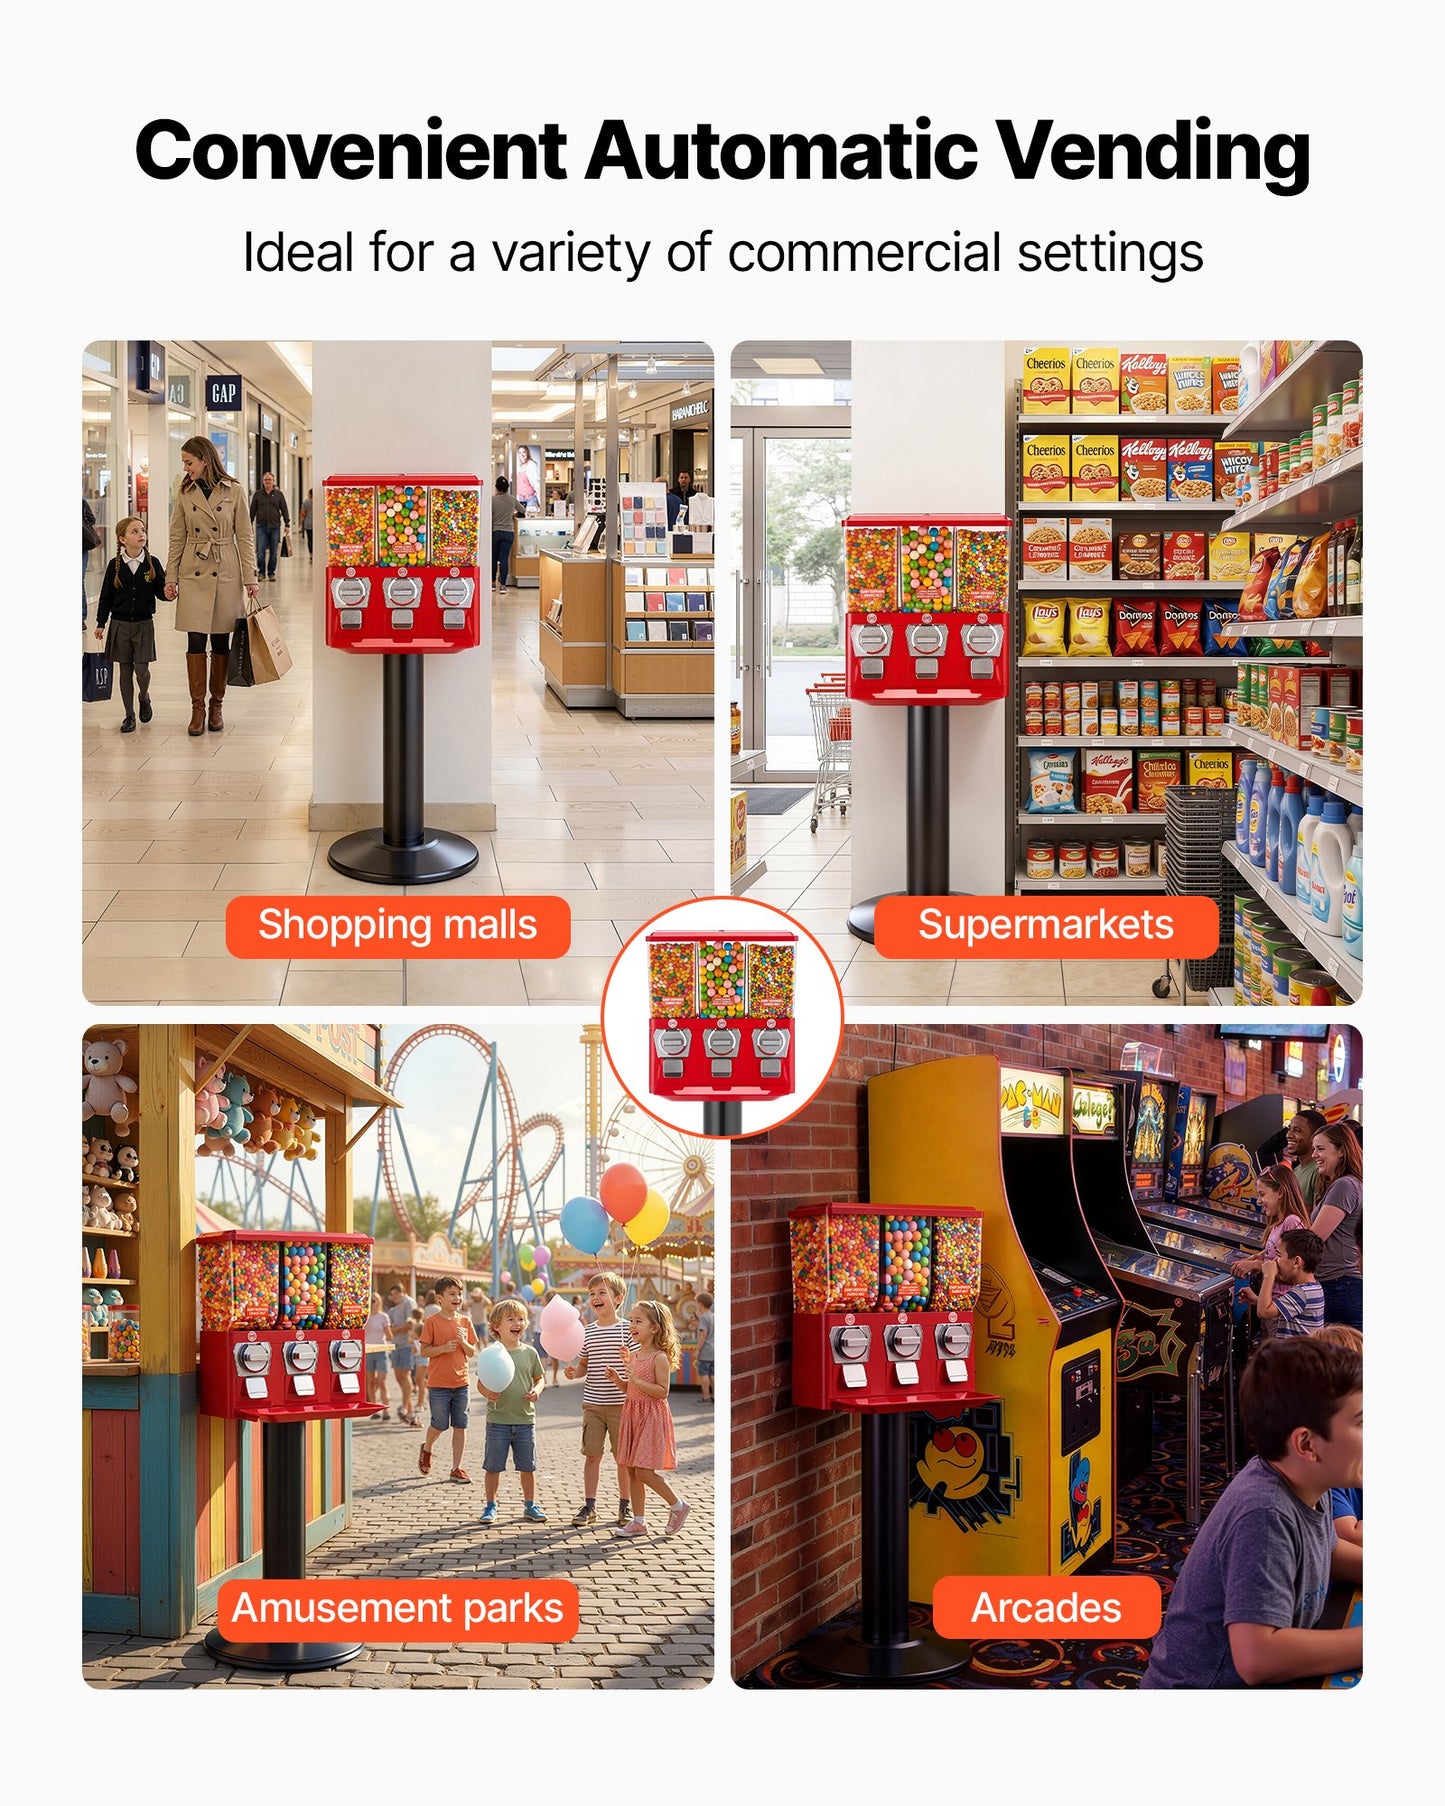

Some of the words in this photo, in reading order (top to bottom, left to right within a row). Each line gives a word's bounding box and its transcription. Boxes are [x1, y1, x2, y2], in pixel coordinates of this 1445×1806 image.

[1026, 357, 1066, 369] Cheerios
[1076, 357, 1115, 369] Cheerios
[212, 383, 236, 403] GAP
[1027, 444, 1066, 456] Cheerios
[1075, 444, 1115, 456] Cheerios
[1193, 758, 1229, 769] Cheerios
